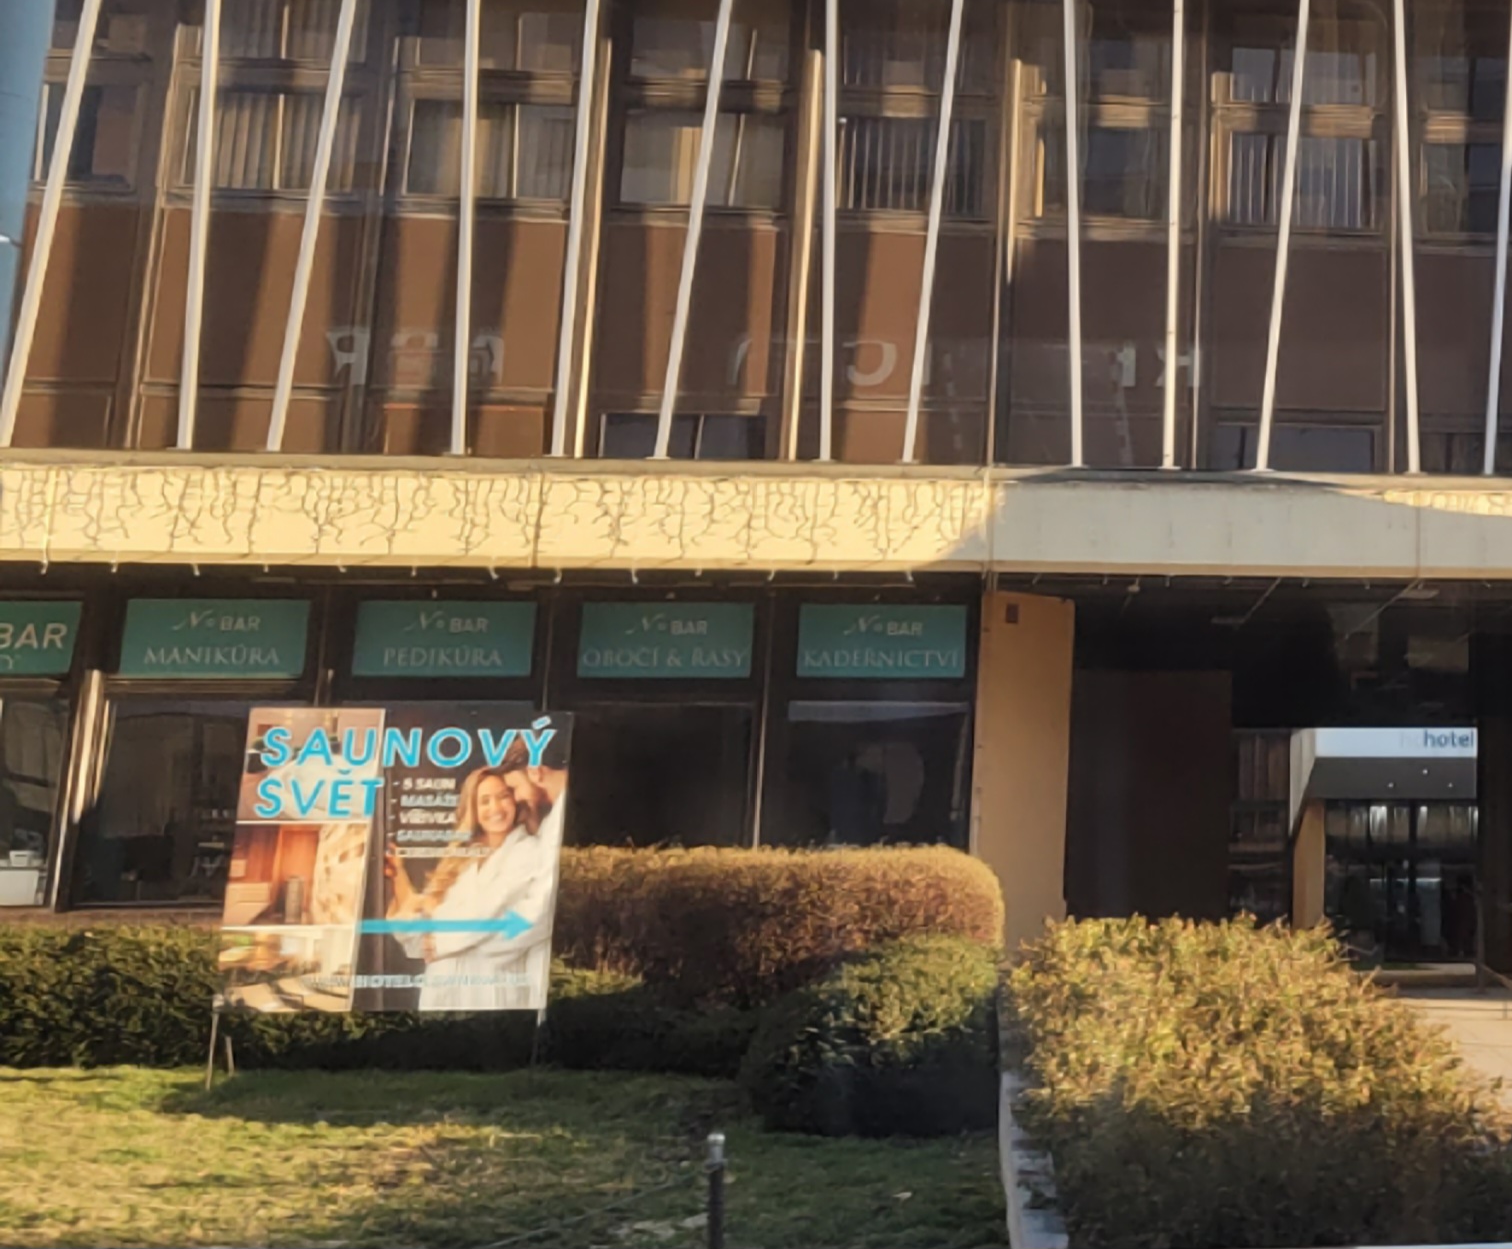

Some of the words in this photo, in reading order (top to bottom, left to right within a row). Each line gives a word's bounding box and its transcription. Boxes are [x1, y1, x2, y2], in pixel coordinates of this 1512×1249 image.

[219, 616, 262, 631] BAR
[450, 617, 489, 633] BAR
[670, 620, 708, 635] BAR
[887, 621, 923, 636] BAR
[143, 644, 281, 665] MANIKÚRA
[383, 645, 503, 666] PEDIKÚRA
[666, 648, 683, 667] &
[259, 715, 557, 768] SAUNOVÝ
[1423, 730, 1474, 748] hotel
[253, 768, 386, 818] SVĚT
